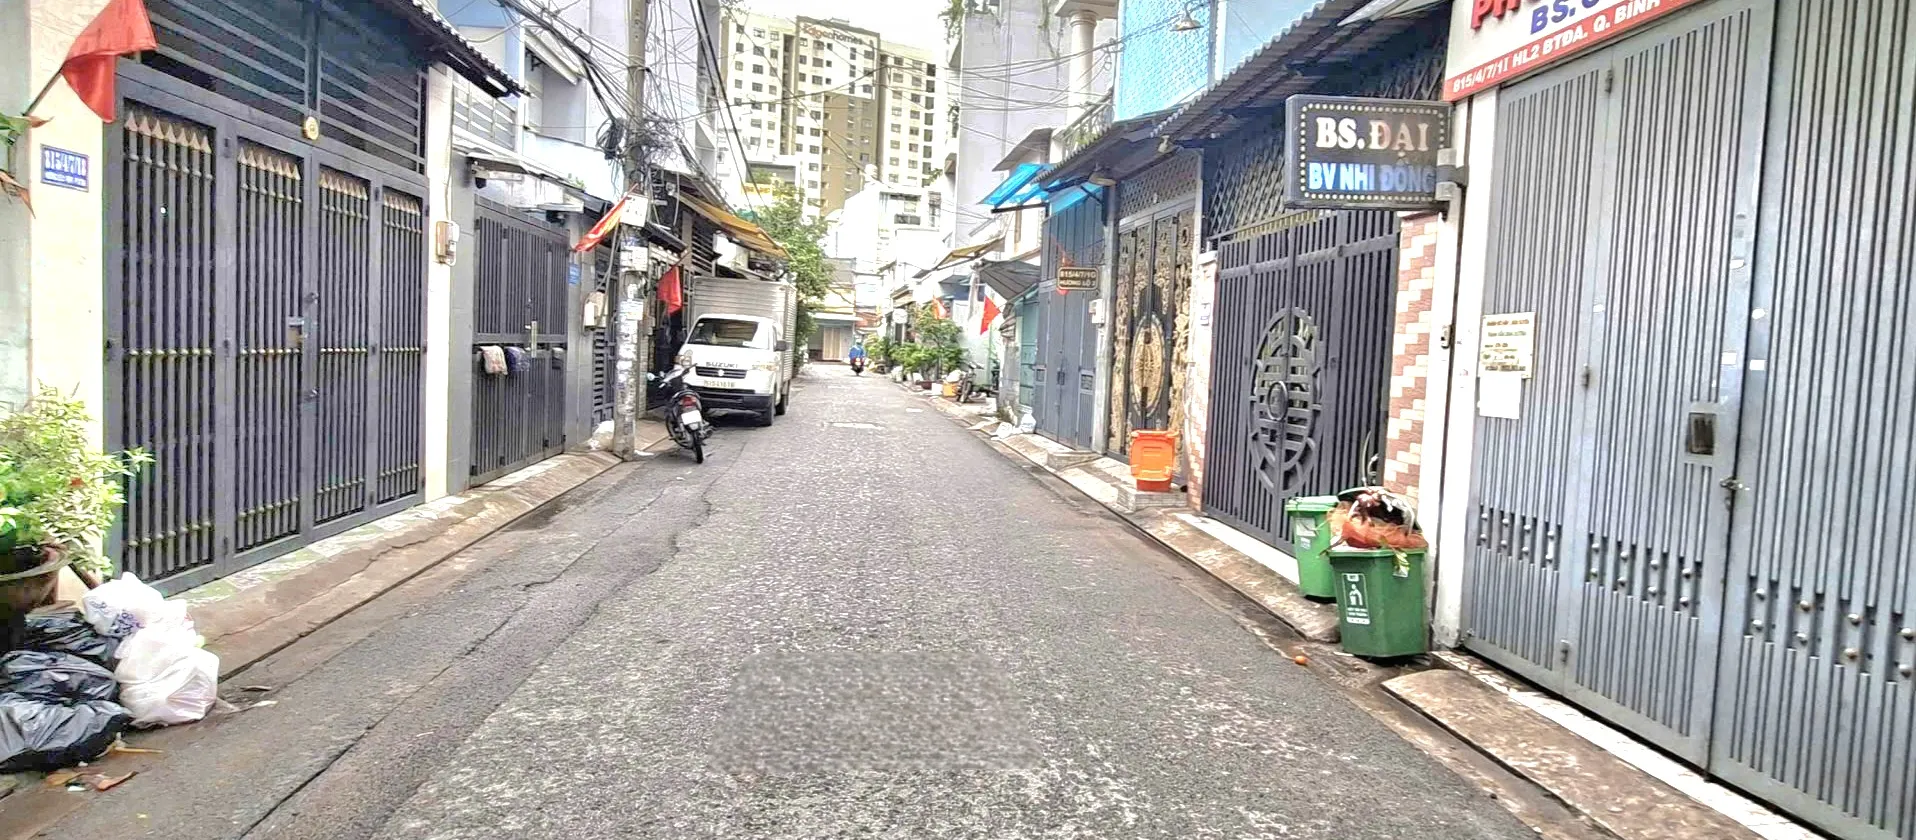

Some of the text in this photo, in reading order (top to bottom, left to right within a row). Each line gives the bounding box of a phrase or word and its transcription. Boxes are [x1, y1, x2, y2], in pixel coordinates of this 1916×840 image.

[1512, 44, 1540, 67] HL2
[1593, 15, 1611, 32] Q.
[1309, 159, 1436, 193] BV NHI ĐỒNG
